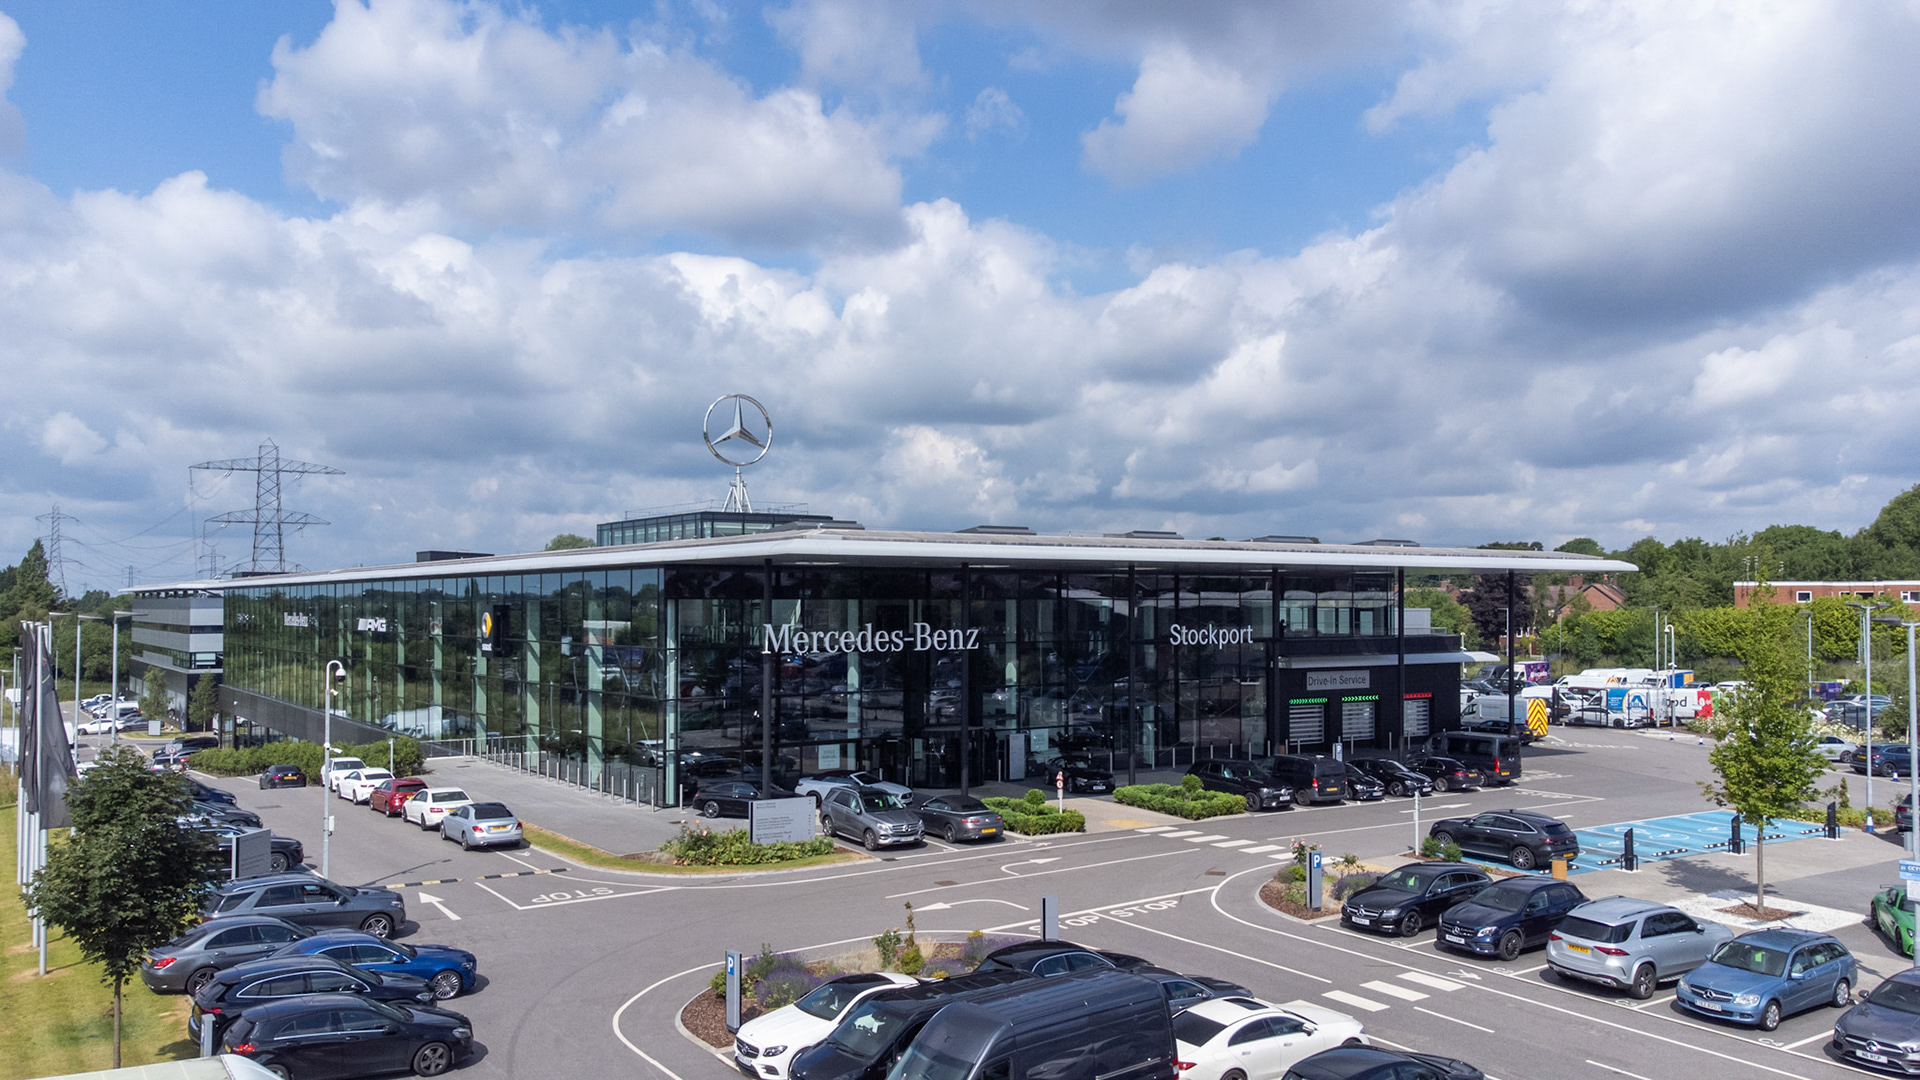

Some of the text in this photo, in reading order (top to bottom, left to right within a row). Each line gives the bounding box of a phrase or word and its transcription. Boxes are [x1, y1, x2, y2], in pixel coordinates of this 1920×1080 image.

[366, 618, 387, 632] AMG
[761, 622, 980, 655] Mercedes-Benz
[1169, 623, 1254, 650] Stockport
[1339, 675, 1366, 685] Service
[1314, 855, 1321, 868] P
[531, 887, 614, 903] STOP
[1109, 899, 1179, 918] STOP
[727, 956, 734, 972] P
[1758, 1037, 1784, 1047] C4
